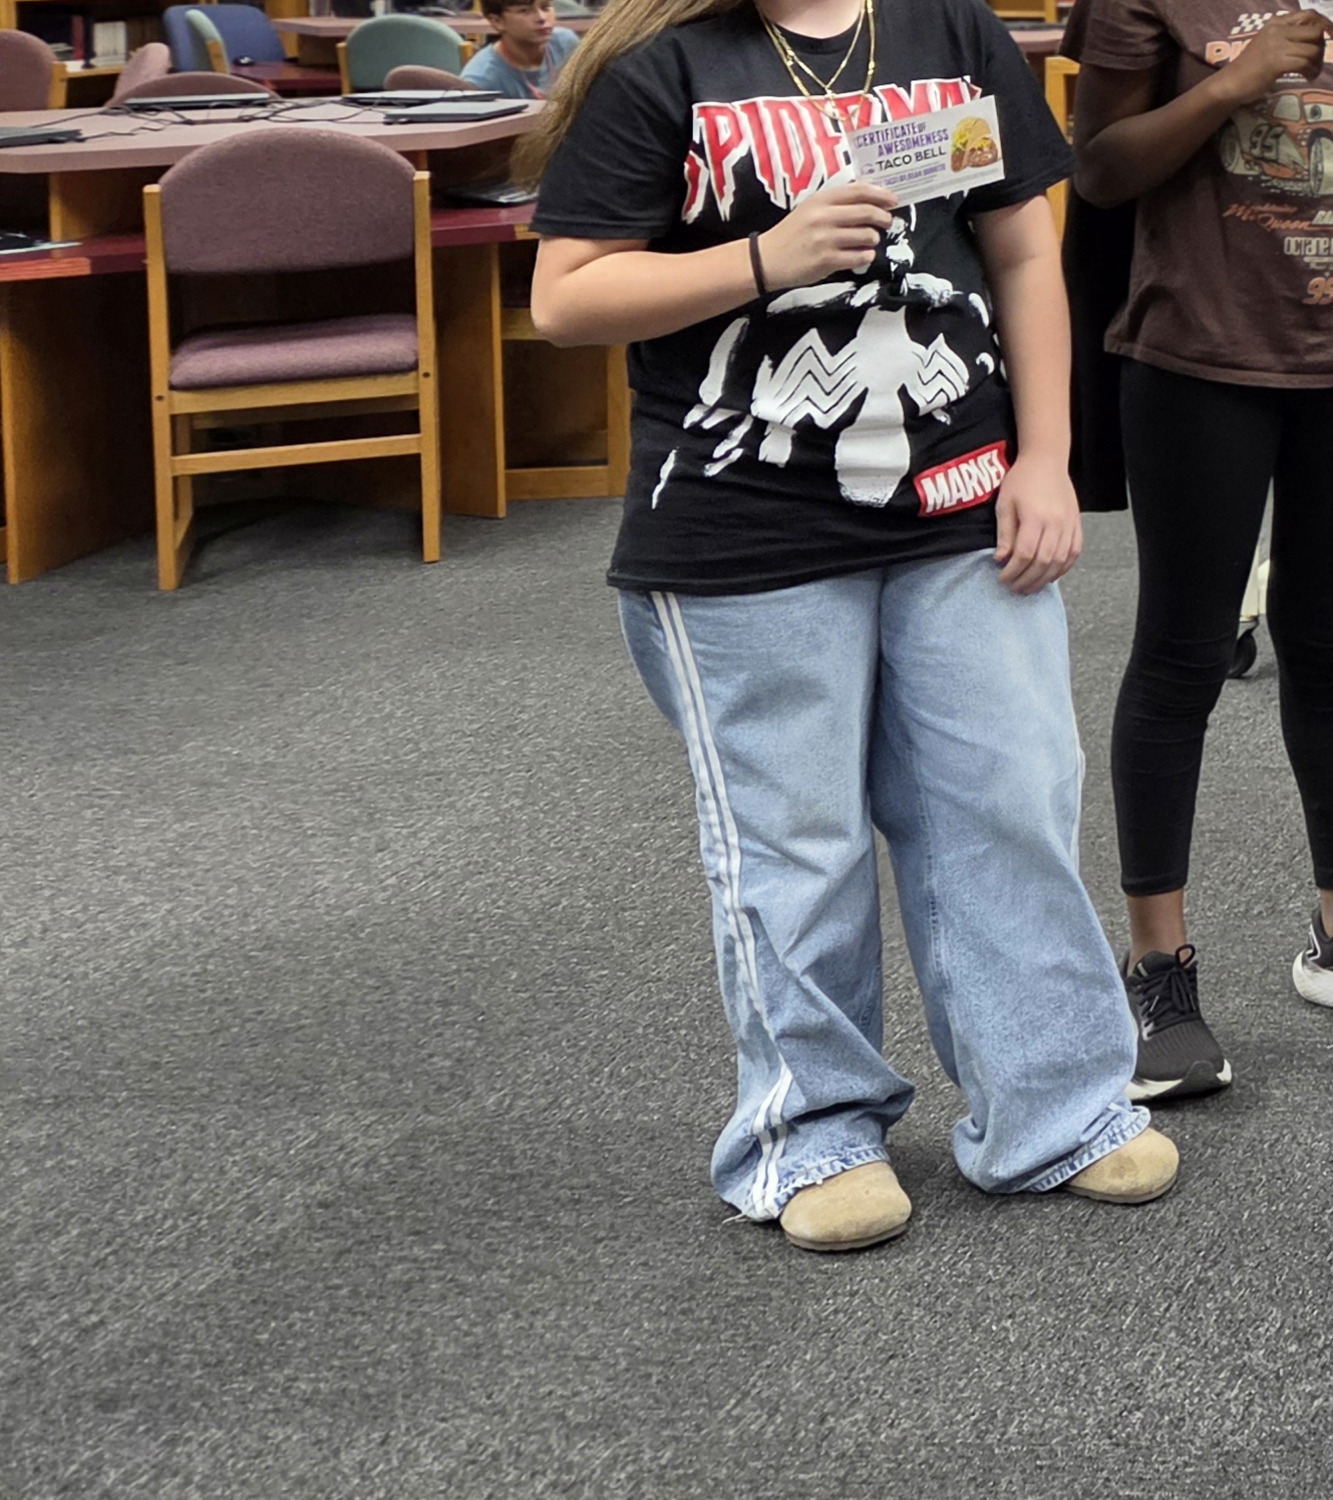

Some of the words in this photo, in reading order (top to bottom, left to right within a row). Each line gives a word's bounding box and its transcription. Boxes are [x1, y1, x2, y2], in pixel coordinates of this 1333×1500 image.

[856, 122, 919, 148] CERTIFICATE
[877, 128, 950, 157] AWESOMENESS
[876, 155, 913, 172] TACO
[915, 146, 947, 162] BELL
